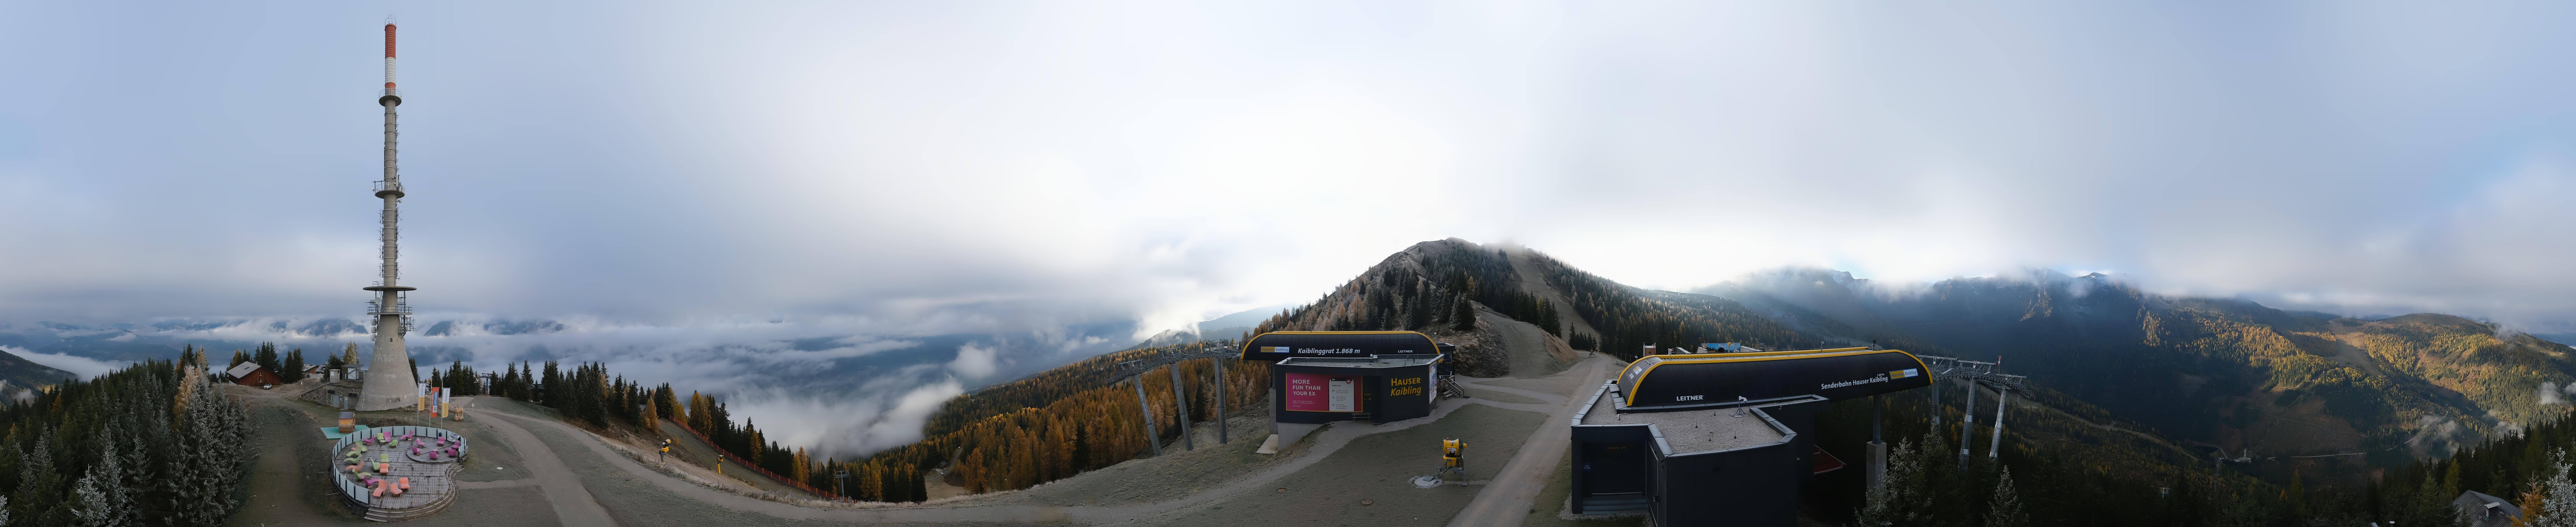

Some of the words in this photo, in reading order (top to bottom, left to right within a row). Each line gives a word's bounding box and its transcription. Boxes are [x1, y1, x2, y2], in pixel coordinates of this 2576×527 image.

[1391, 378, 1421, 386] HAUSER
[1821, 379, 1852, 389] Senderbahn
[1391, 386, 1421, 396] Kaibling
